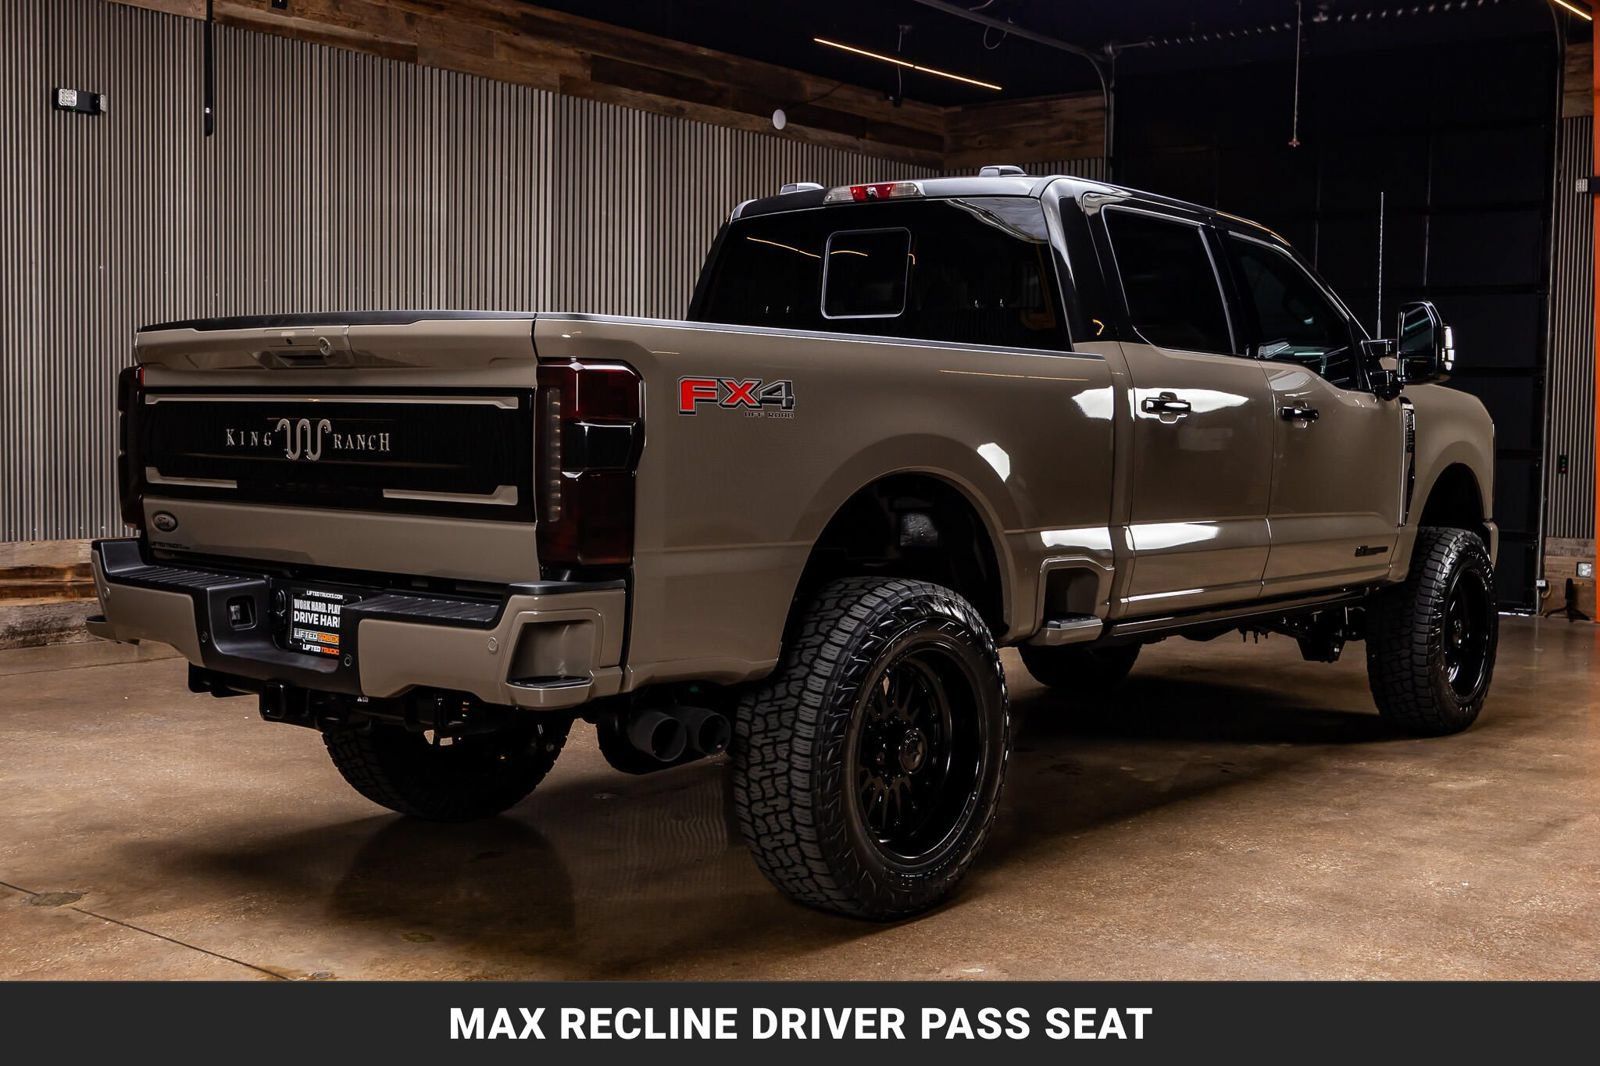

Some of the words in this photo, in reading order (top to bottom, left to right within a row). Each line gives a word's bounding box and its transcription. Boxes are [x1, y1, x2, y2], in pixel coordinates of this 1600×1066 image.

[678, 375, 795, 416] FX4
[767, 411, 794, 419] ROAD
[226, 428, 272, 447] KING
[333, 432, 390, 451] RANCH
[294, 599, 310, 610] WORK
[294, 610, 319, 625] DRIVE
